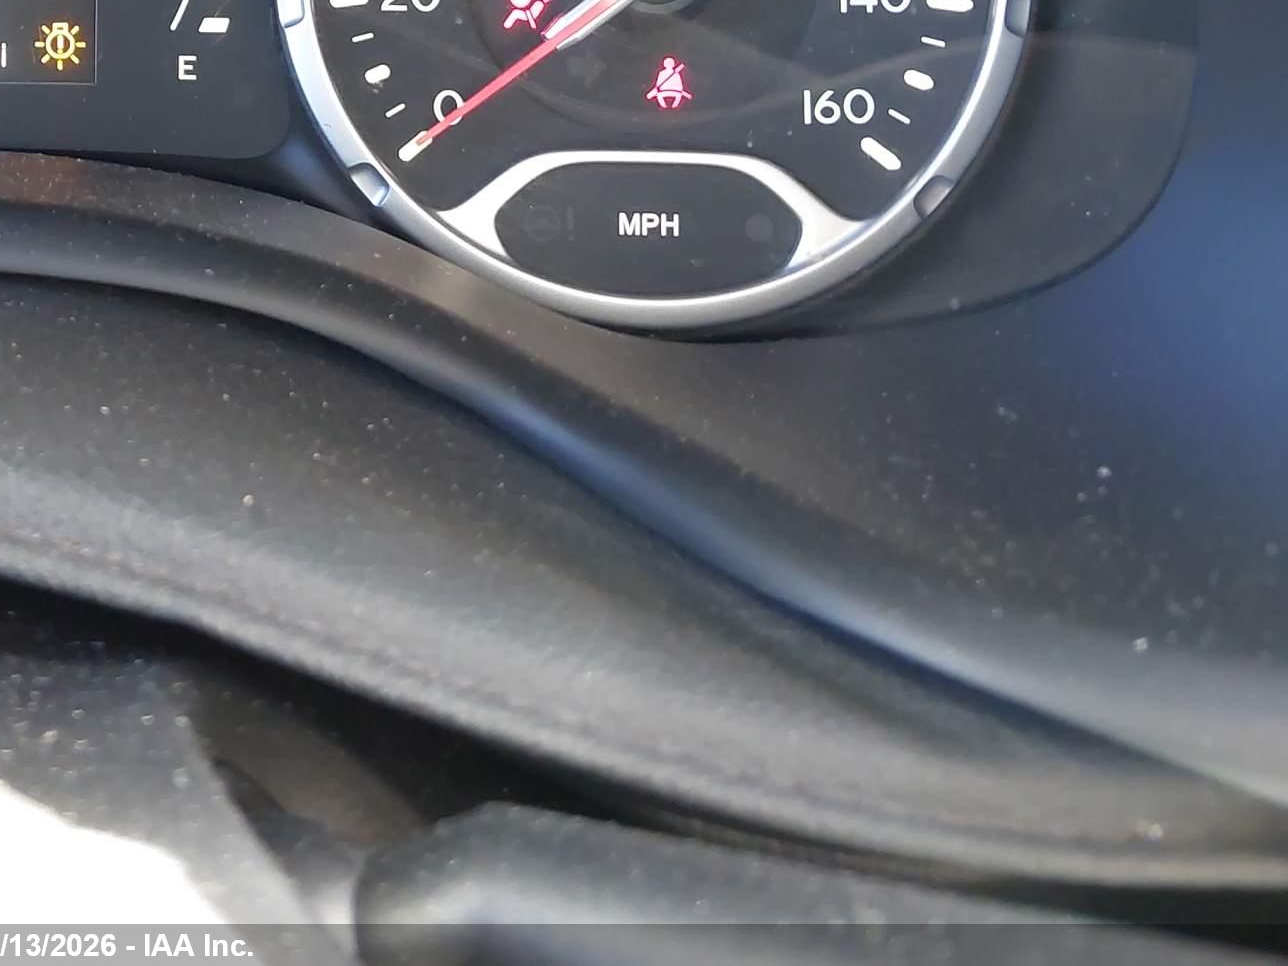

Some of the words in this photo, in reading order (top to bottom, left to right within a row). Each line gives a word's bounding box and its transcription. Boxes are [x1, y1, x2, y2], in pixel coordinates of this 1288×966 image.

[178, 55, 197, 81] E
[433, 89, 464, 126] 0
[803, 88, 875, 125] 160
[618, 212, 680, 237] MPH
